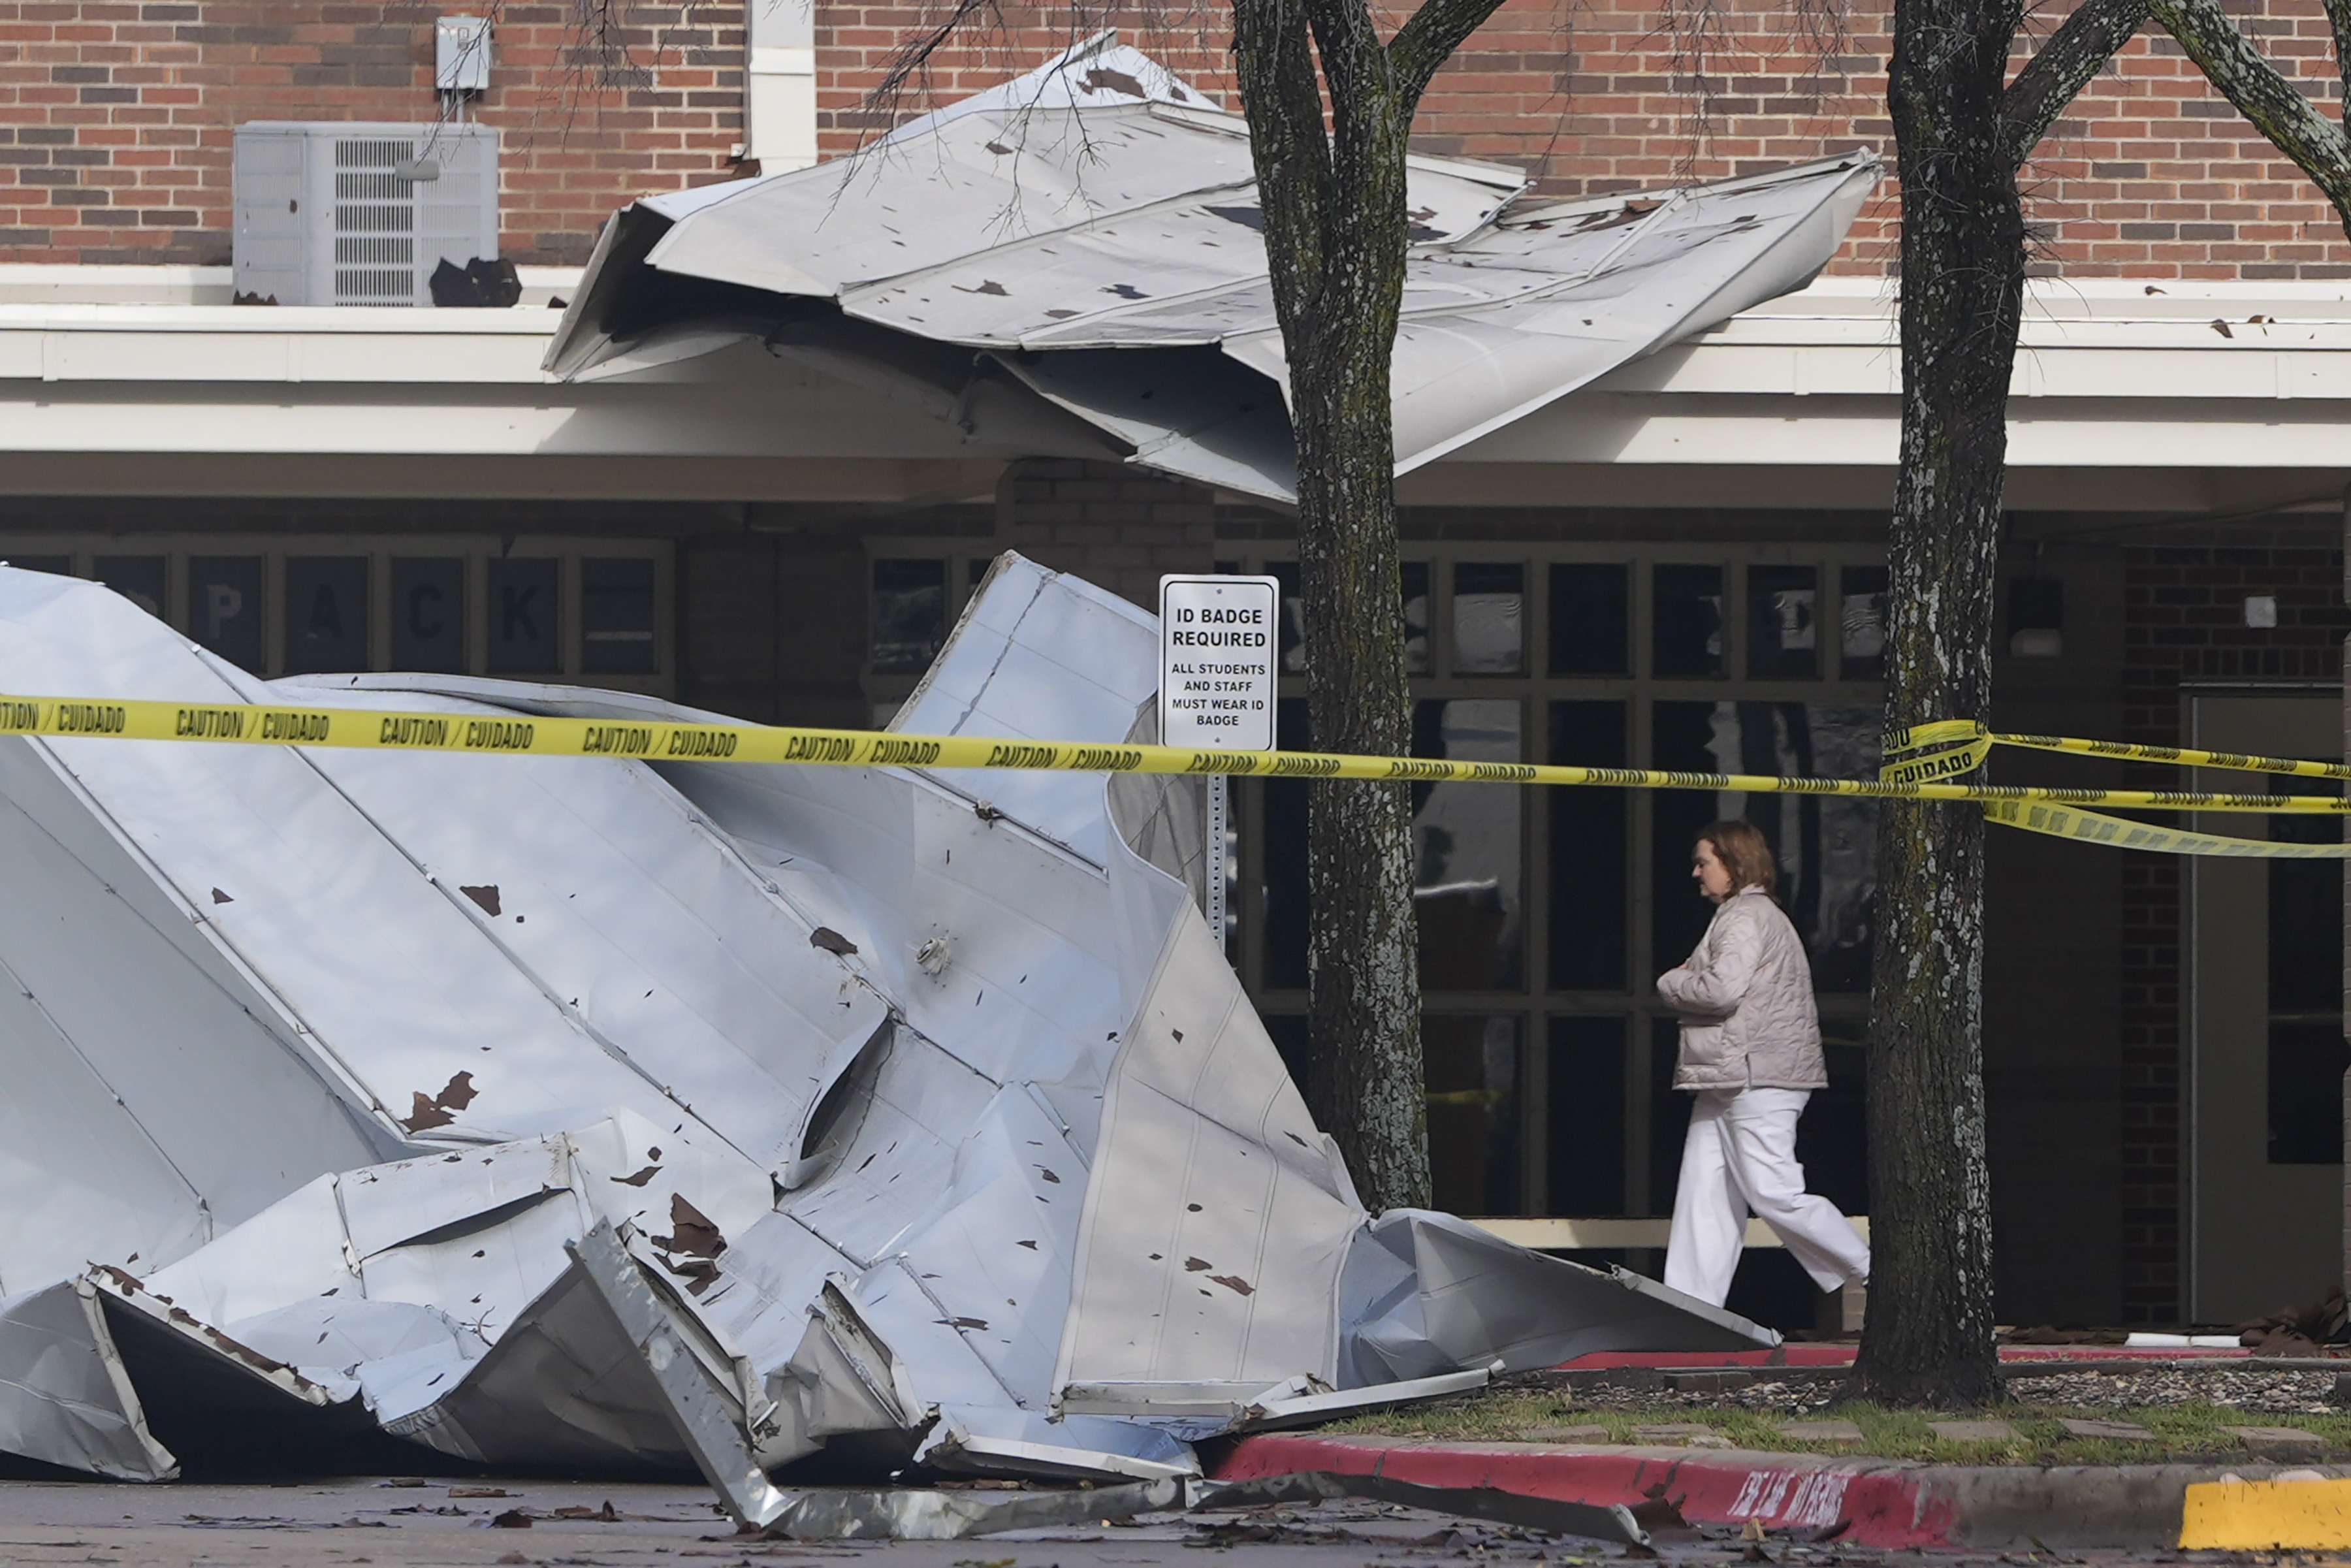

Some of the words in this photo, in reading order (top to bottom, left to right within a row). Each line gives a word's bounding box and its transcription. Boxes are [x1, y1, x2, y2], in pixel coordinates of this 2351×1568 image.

[1177, 608, 1194, 623] ID
[1201, 609, 1262, 624] BADGE
[1173, 631, 1266, 647] REQUIRED
[1172, 663, 1194, 674] ALL
[1199, 664, 1266, 675] STUDENTS
[1184, 681, 1210, 691] AND
[1214, 681, 1252, 692] STAFF
[1172, 699, 1207, 709] MUST
[1211, 699, 1248, 710] WEAR
[1252, 700, 1264, 711] ID
[59, 704, 125, 733] CUIDADO
[176, 709, 244, 738] CAUTION
[263, 712, 329, 741] CUIDADO
[1197, 715, 1239, 726] BADGE
[379, 718, 448, 746] CAUTION
[465, 721, 534, 749] CUIDADO
[583, 727, 652, 754] CAUTION
[667, 730, 738, 758] CUIDADO
[784, 736, 855, 762] CAUTION
[869, 740, 940, 764] CUIDADO
[985, 746, 1057, 769] CAUTION
[1069, 749, 1142, 771] CUIDADO
[1185, 754, 1257, 774] CAUTION
[1895, 752, 1972, 783] CUIDADO
